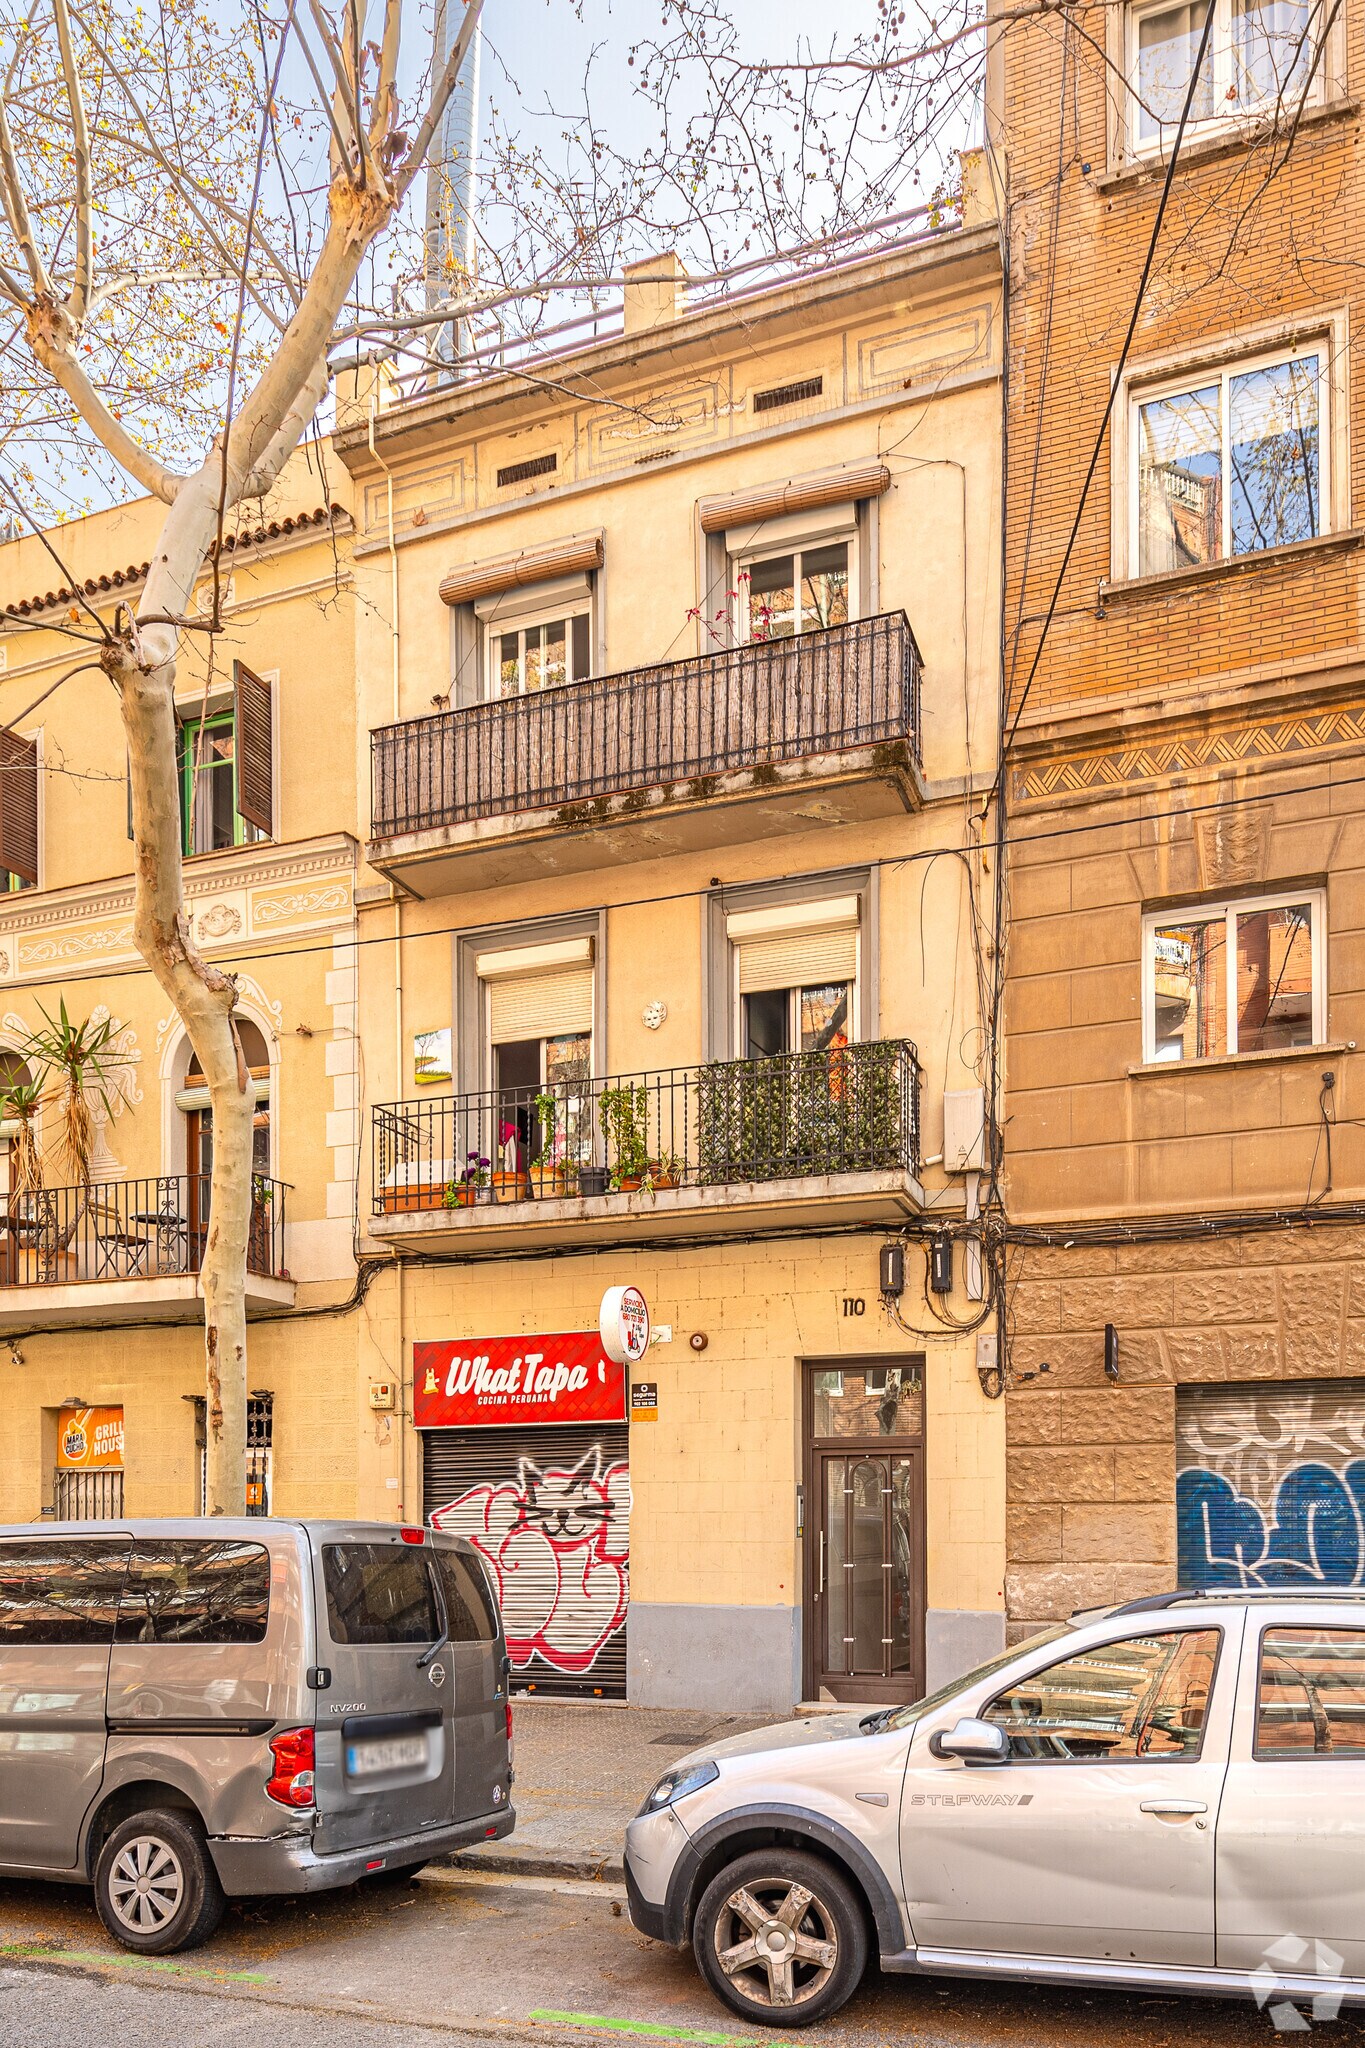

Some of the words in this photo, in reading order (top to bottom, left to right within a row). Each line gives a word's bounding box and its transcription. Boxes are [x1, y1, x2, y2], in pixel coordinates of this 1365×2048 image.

[623, 1297, 643, 1309] SERVICIO
[843, 1298, 866, 1317] 110
[624, 1305, 646, 1317] DOMICILIO
[477, 1395, 507, 1406] COCINA
[510, 1393, 548, 1404] PERUANA
[96, 1420, 124, 1440] GRILL
[66, 1433, 83, 1445] MARA
[65, 1441, 84, 1454] CUCHO
[330, 1702, 366, 1713] NV200
[910, 1794, 1019, 1807] STEPWAY
